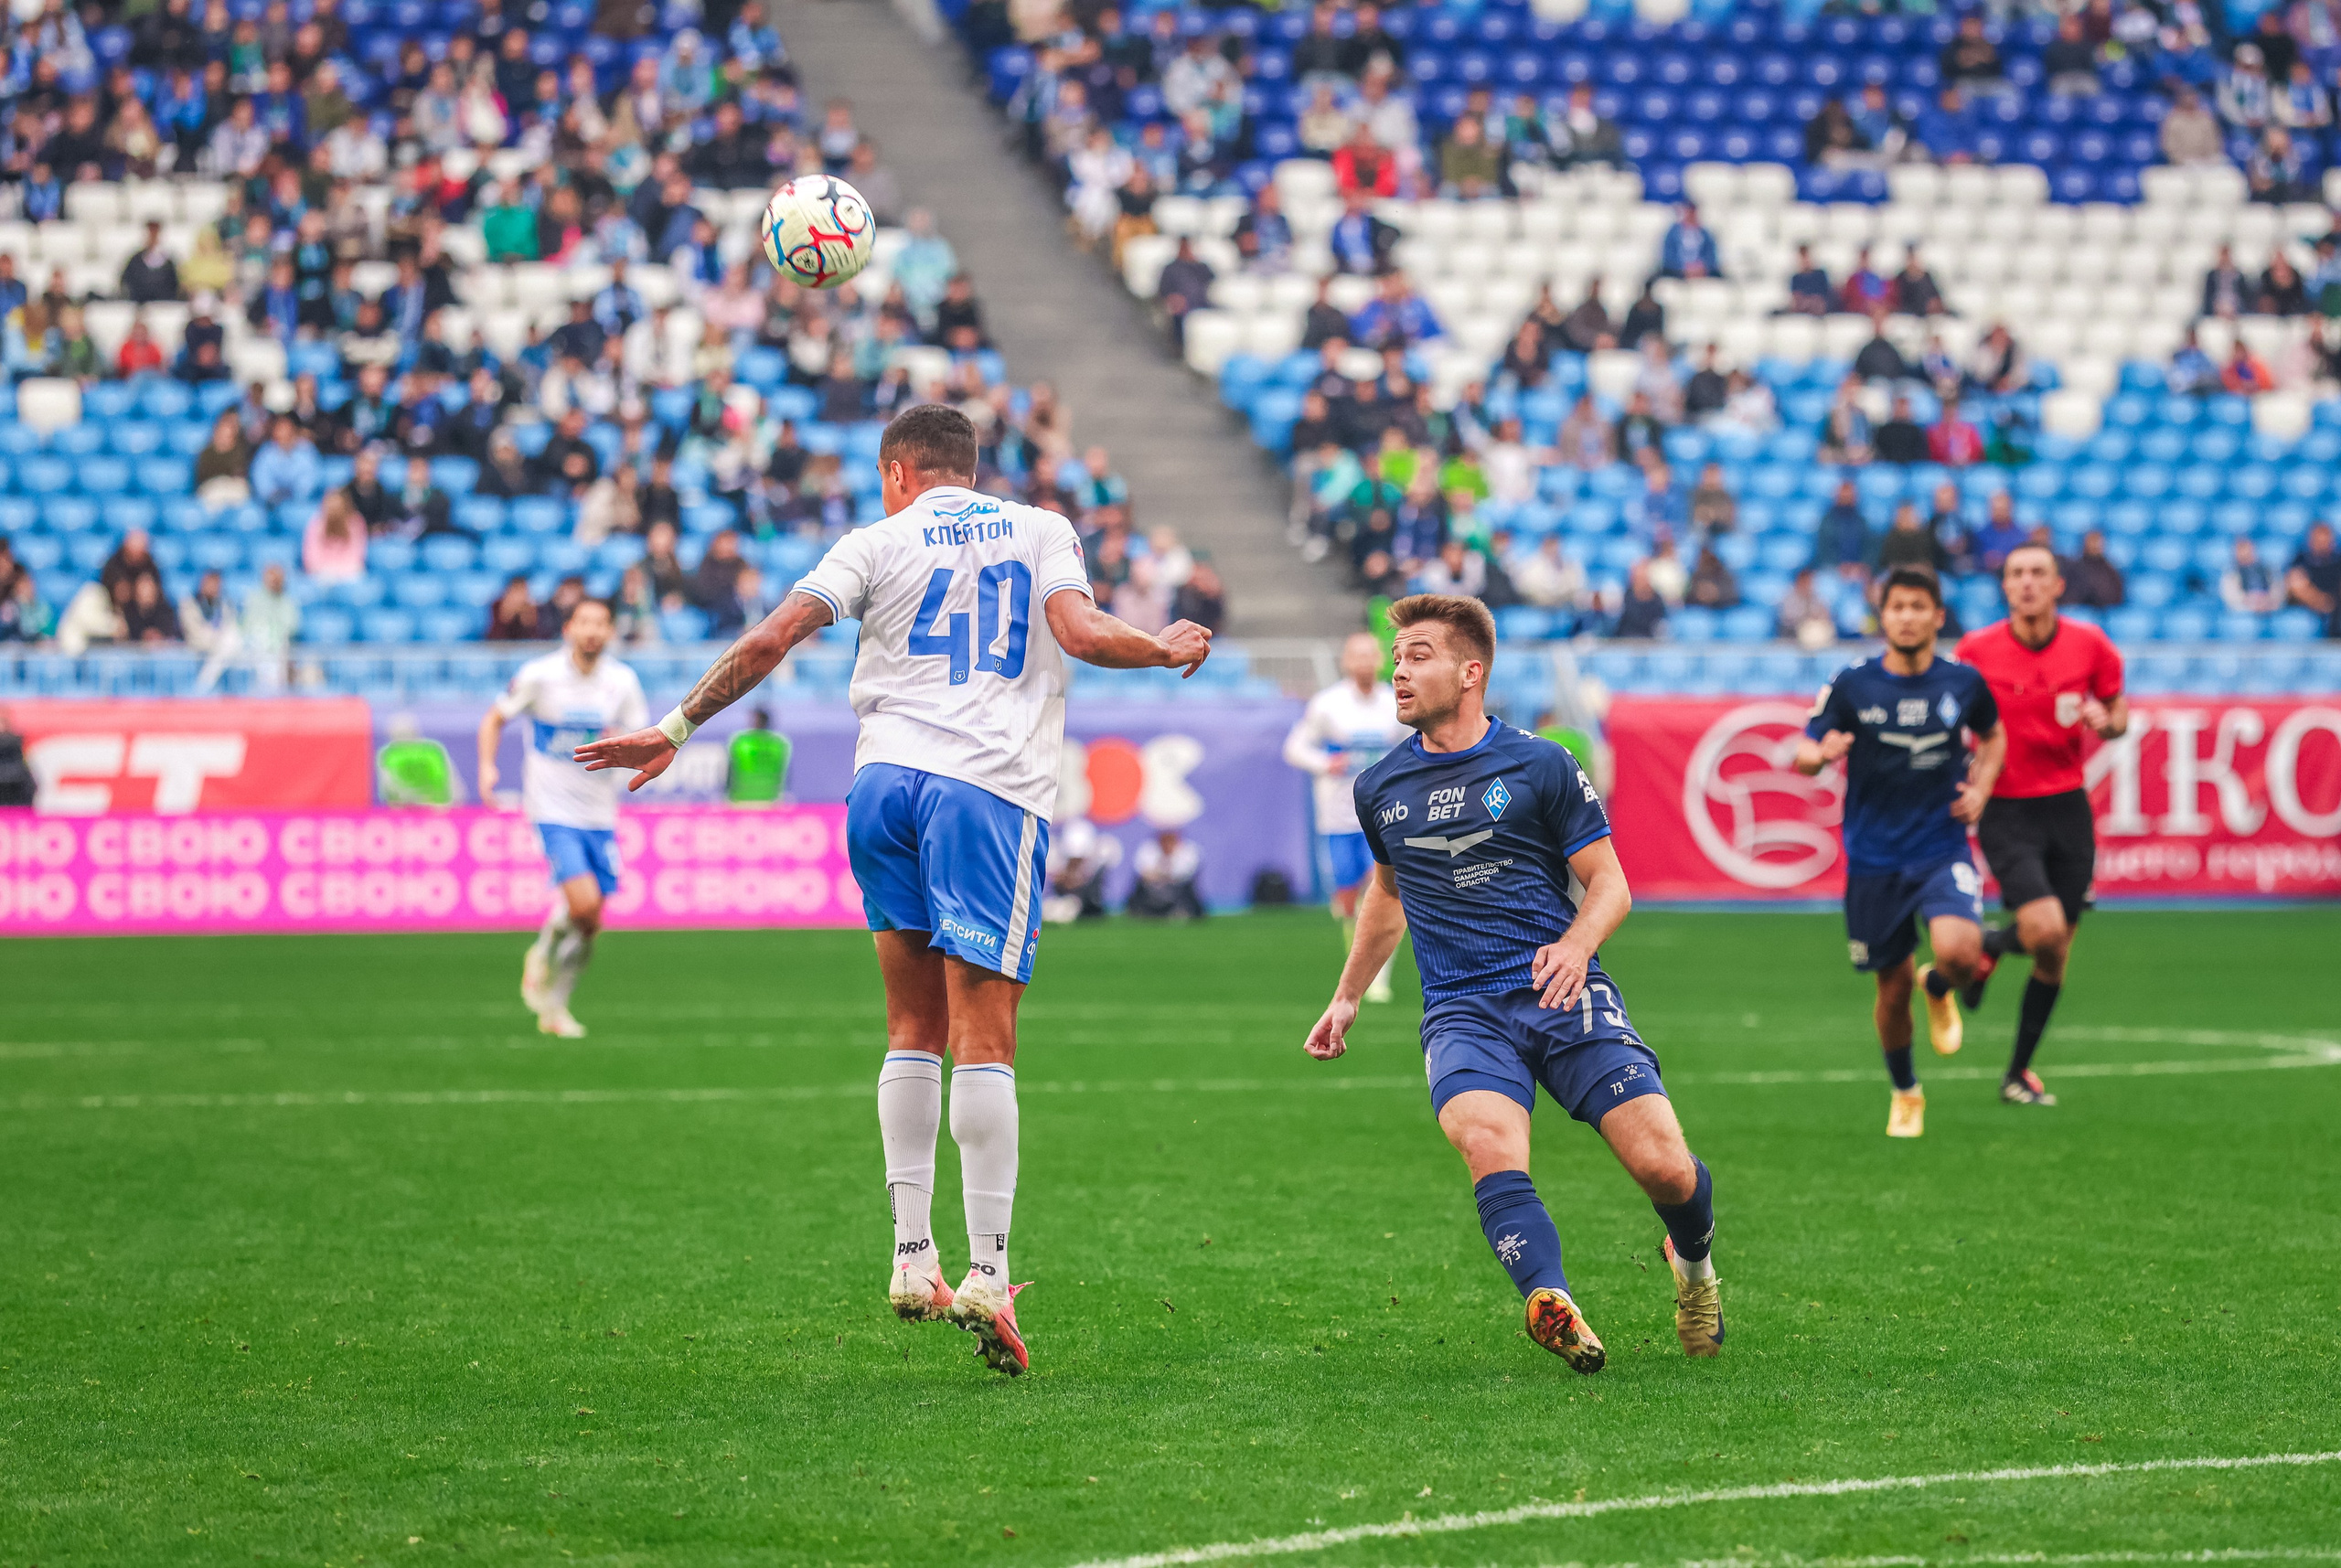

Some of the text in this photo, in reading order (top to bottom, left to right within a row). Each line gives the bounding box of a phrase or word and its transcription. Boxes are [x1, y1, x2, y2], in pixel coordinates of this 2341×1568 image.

[923, 518, 1012, 547] КЛЕЙТОН
[908, 560, 1031, 686] 40
[1427, 786, 1466, 805] FON
[1382, 801, 1409, 824] wb
[1427, 803, 1465, 821] BET
[1453, 859, 1513, 876] ПРАВИТЕЛЬСТВО
[1454, 867, 1500, 882] САМАРСКОЙ
[1455, 876, 1491, 889] ОБЛАСТИ
[1623, 1072, 1646, 1083] KELME
[1609, 1082, 1624, 1096] 73
[898, 1238, 930, 1256] PRO
[1505, 1250, 1521, 1266] 73
